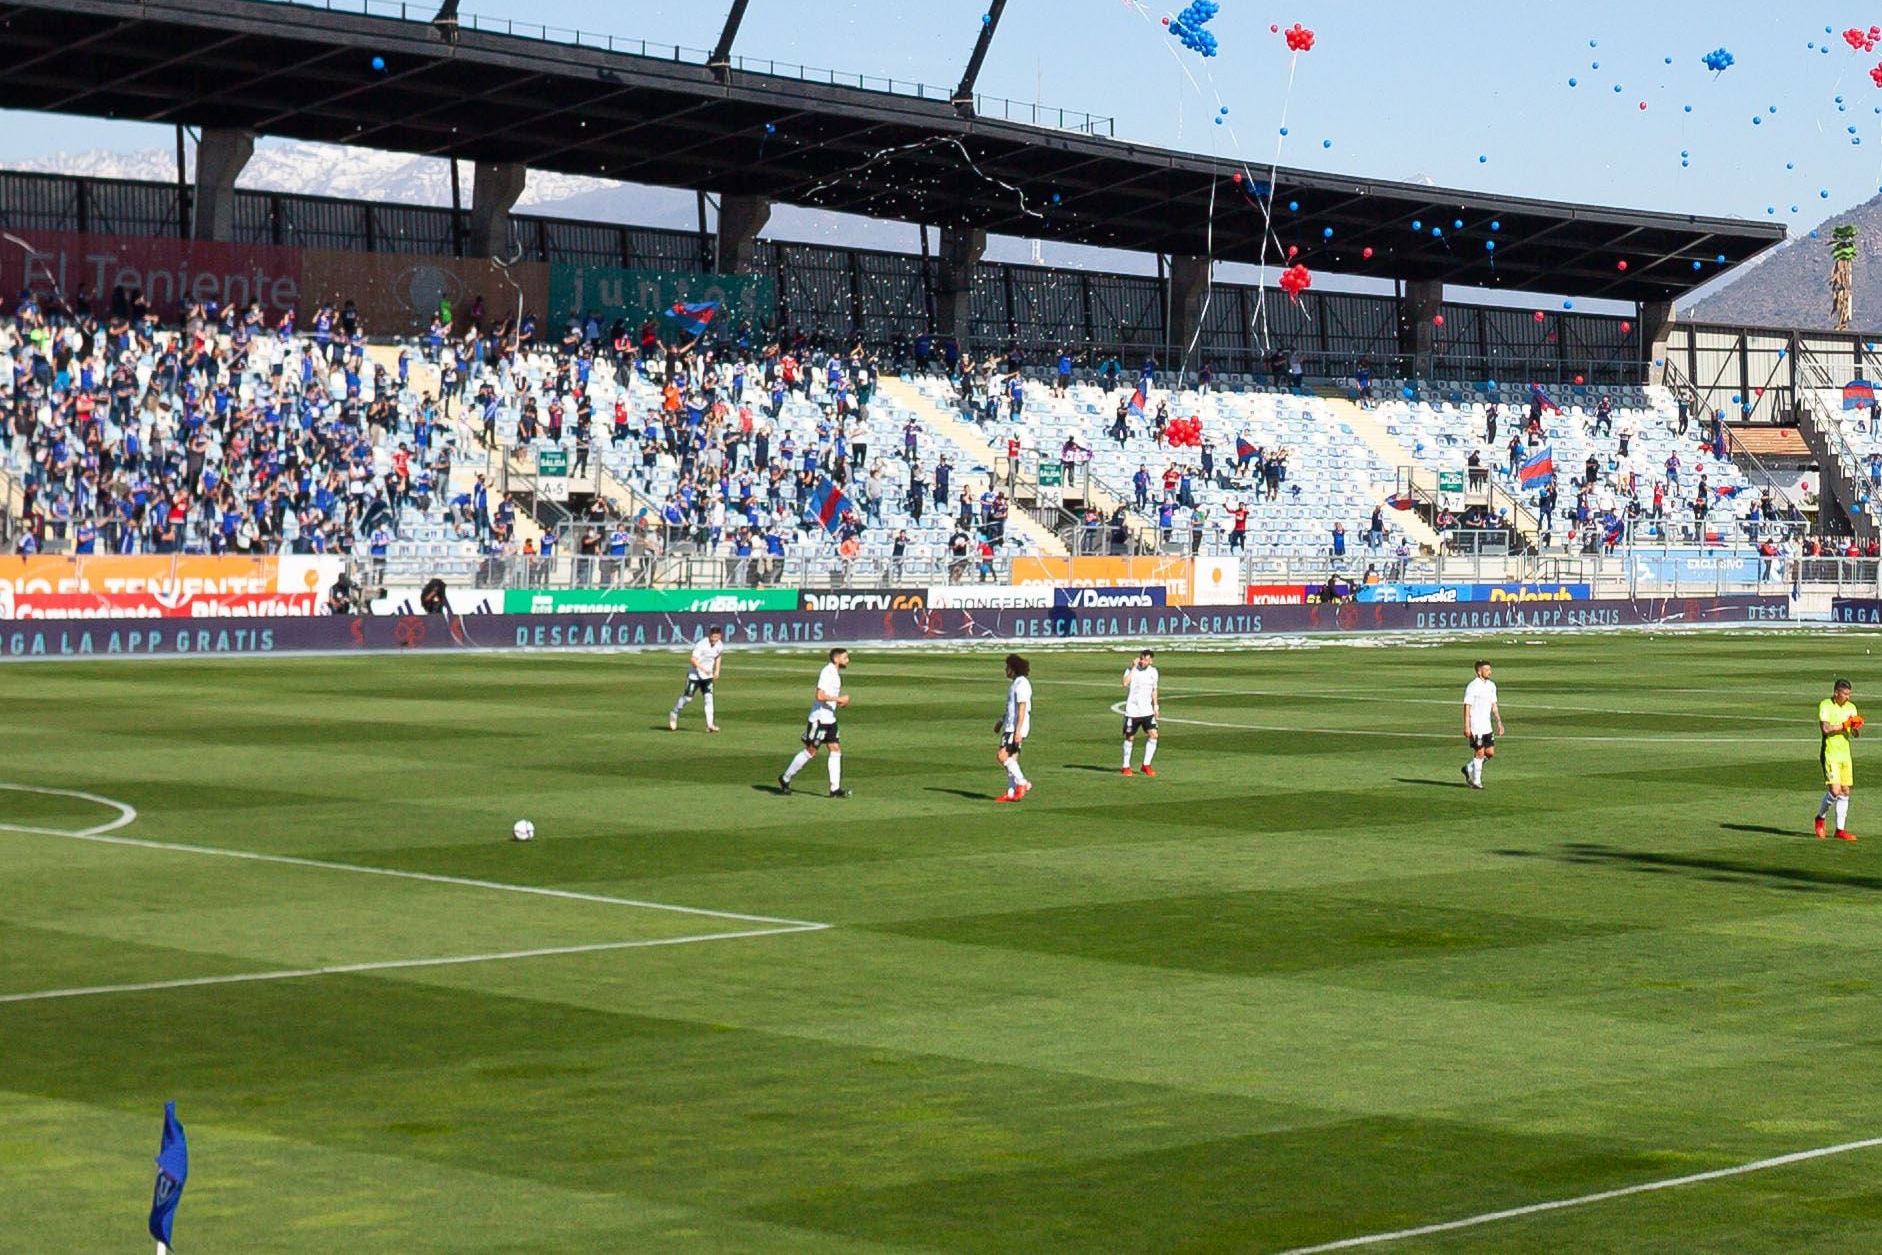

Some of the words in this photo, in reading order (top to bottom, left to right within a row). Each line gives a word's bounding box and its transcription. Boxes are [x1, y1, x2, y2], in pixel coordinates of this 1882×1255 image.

[23, 251, 67, 298] El
[86, 254, 298, 310] Teniente
[544, 482, 564, 495] A-5
[1443, 496, 1461, 508] A-7
[1253, 595, 1302, 605] KONAMI
[1015, 616, 1120, 637] DESCARGA
[1128, 617, 1149, 635] LA
[1157, 616, 1192, 635] APP
[1200, 614, 1263, 633] GRATIS
[1417, 610, 1501, 628] DESCARGA
[1509, 610, 1525, 626] LA
[1532, 609, 1561, 626] APP
[1568, 609, 1620, 626] GRATIS
[61, 631, 94, 655] LA
[108, 631, 163, 653] APP
[176, 628, 274, 652] GRATIS
[516, 623, 646, 646] DESCARGA
[657, 622, 690, 644] LA
[694, 621, 736, 643] AP
[743, 620, 825, 642] GRATIS
